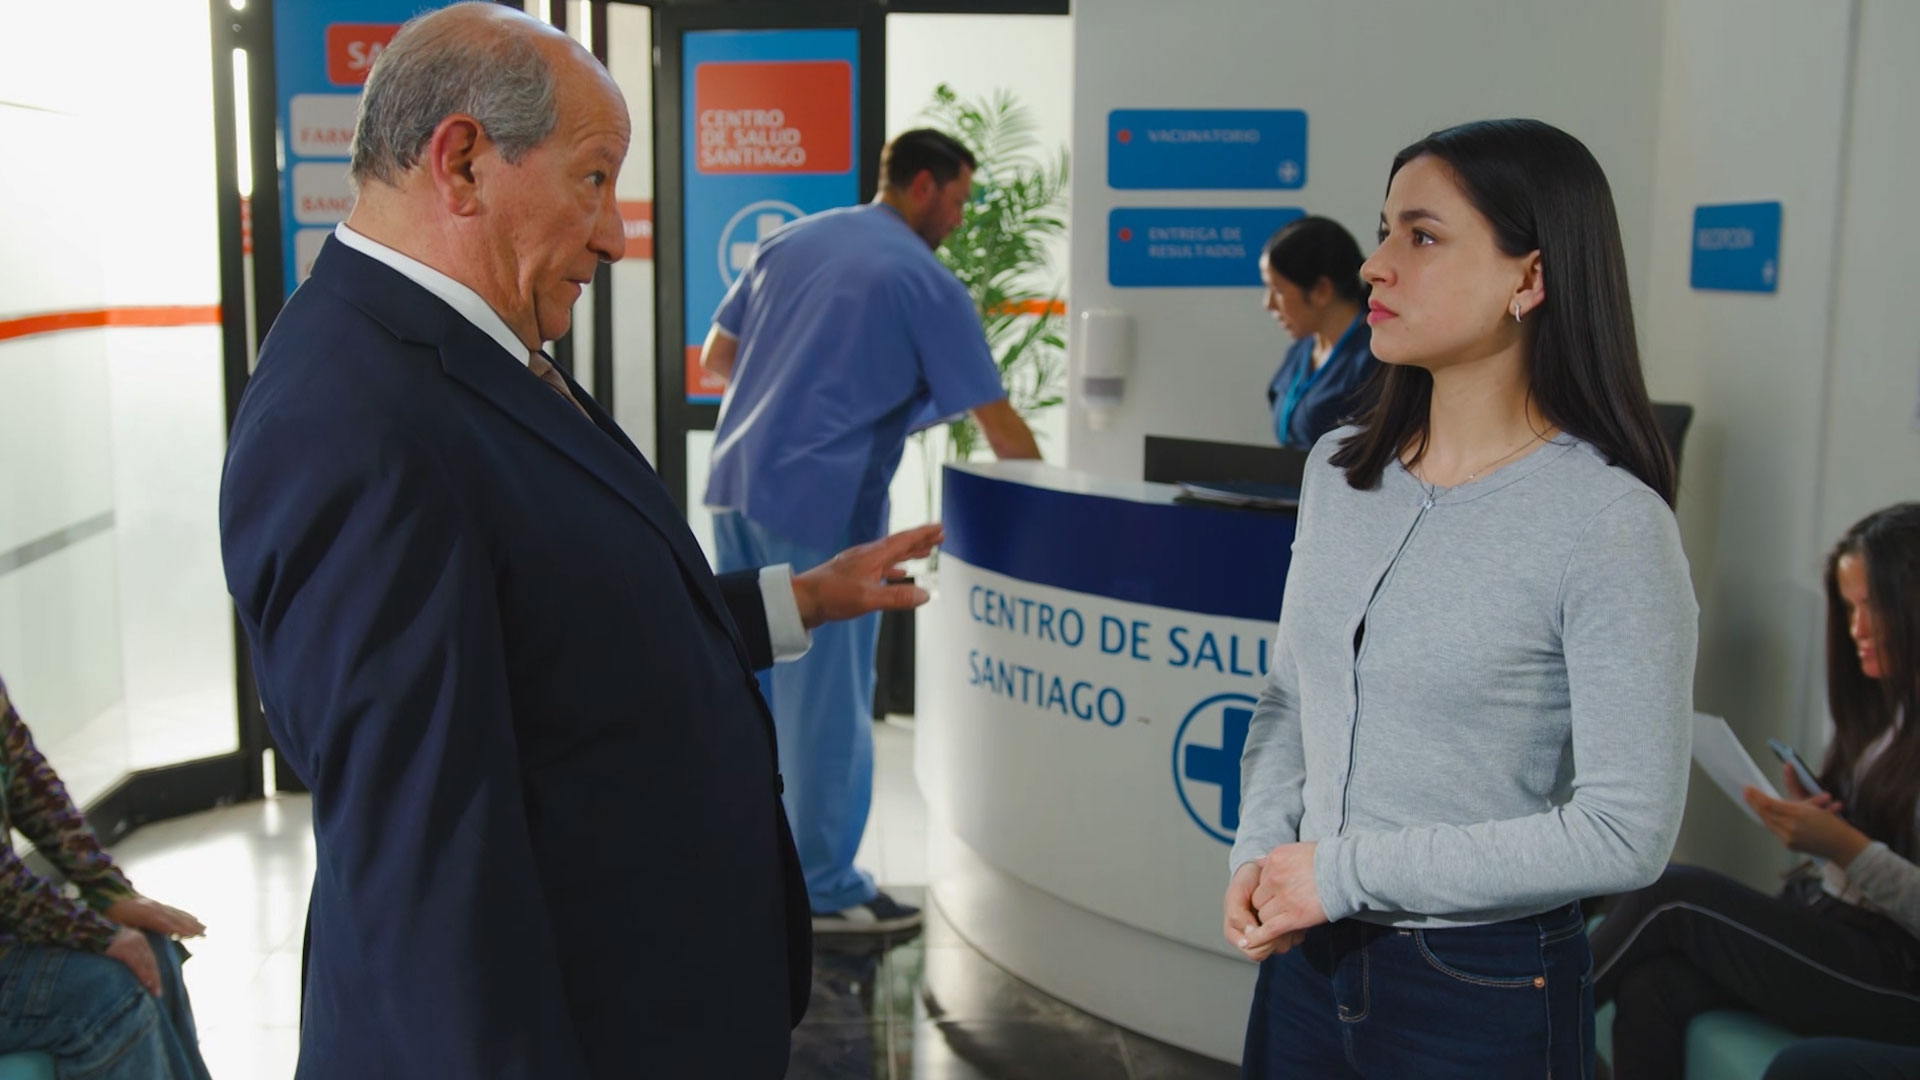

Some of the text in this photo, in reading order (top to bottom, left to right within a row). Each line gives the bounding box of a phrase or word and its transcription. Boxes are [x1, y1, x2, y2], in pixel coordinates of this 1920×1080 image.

[701, 109, 784, 128] CENTRO
[701, 128, 801, 147] DE SALUD
[1147, 129, 1260, 143] VACUNATORIO
[701, 147, 806, 167] SANTIAGO
[1148, 227, 1242, 241] ENTREGA DE
[1148, 244, 1245, 258] RESULTADOS
[969, 585, 1085, 647] CENTRO
[1099, 615, 1151, 661] DE
[968, 649, 1126, 727] SANTIAGO
